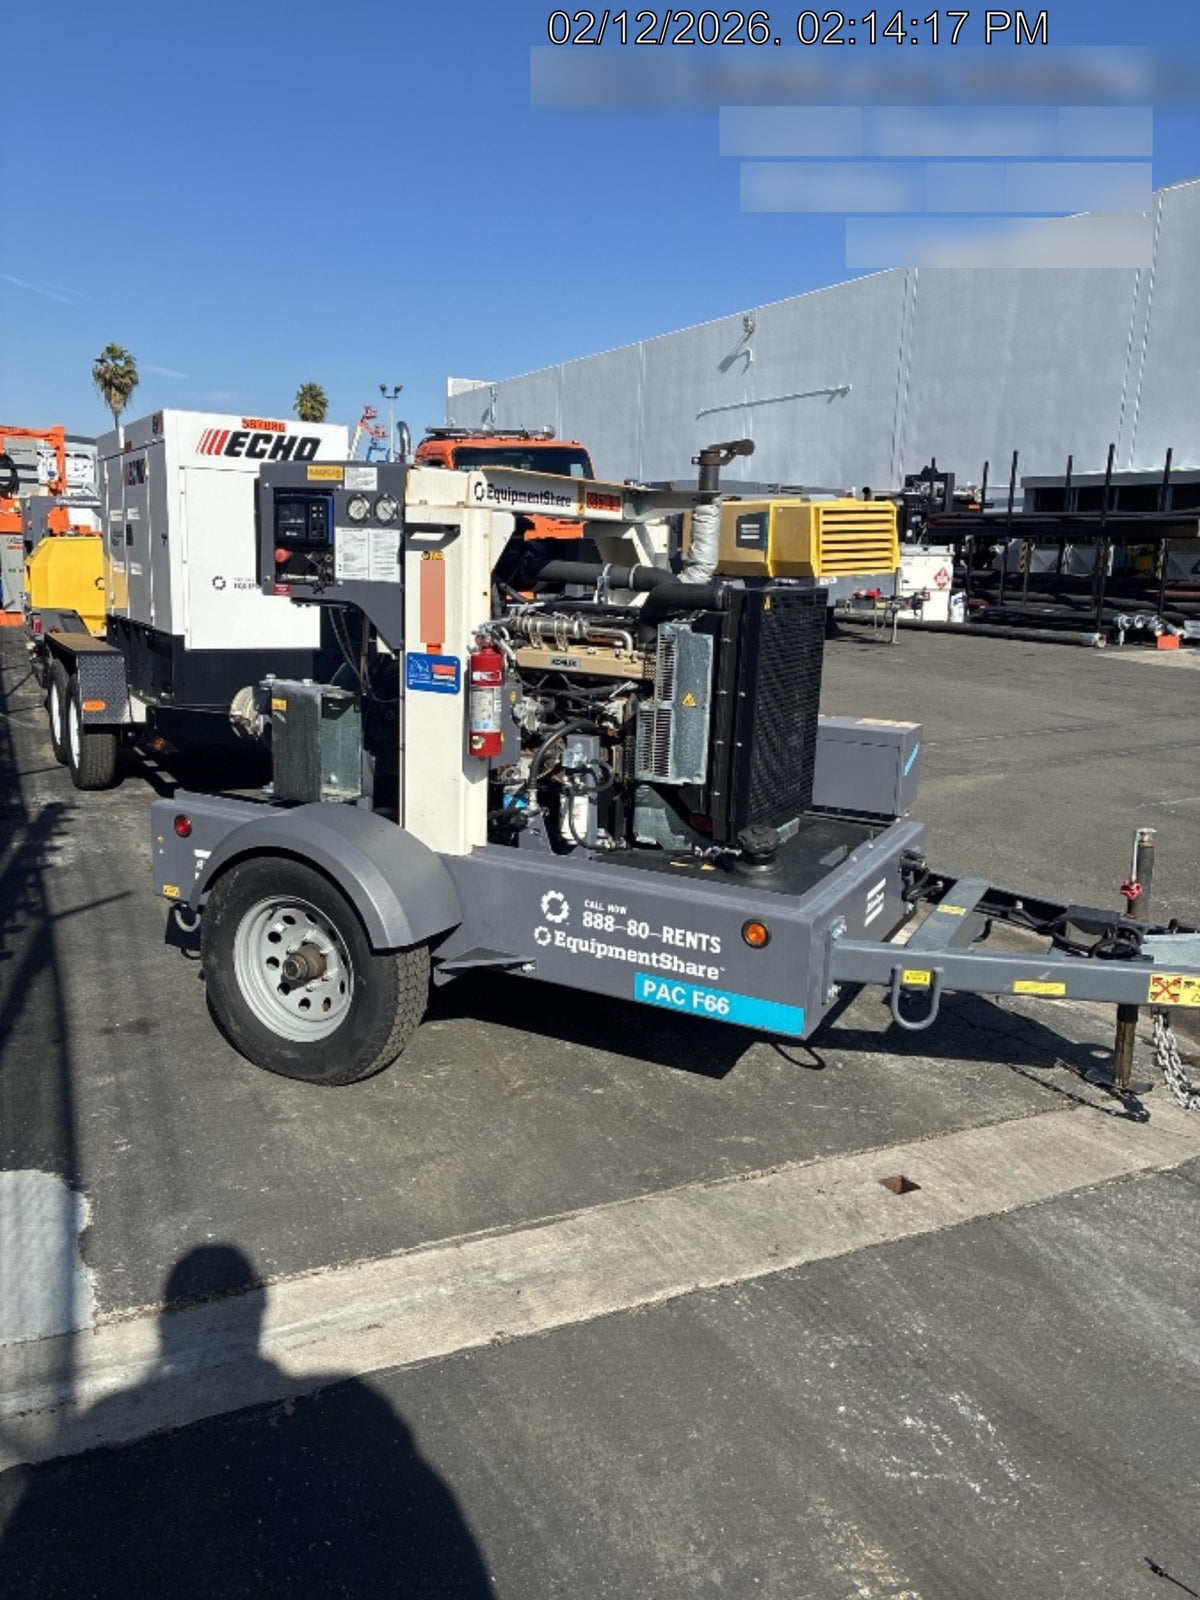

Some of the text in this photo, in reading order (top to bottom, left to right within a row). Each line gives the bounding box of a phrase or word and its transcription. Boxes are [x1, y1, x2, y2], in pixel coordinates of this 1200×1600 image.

[224, 430, 321, 461] ECHO
[584, 899, 627, 915] CALL NOW
[582, 911, 722, 954] 888-80-RENTS
[554, 929, 720, 980] EquipmentShare
[643, 979, 730, 1014] PAC F66
